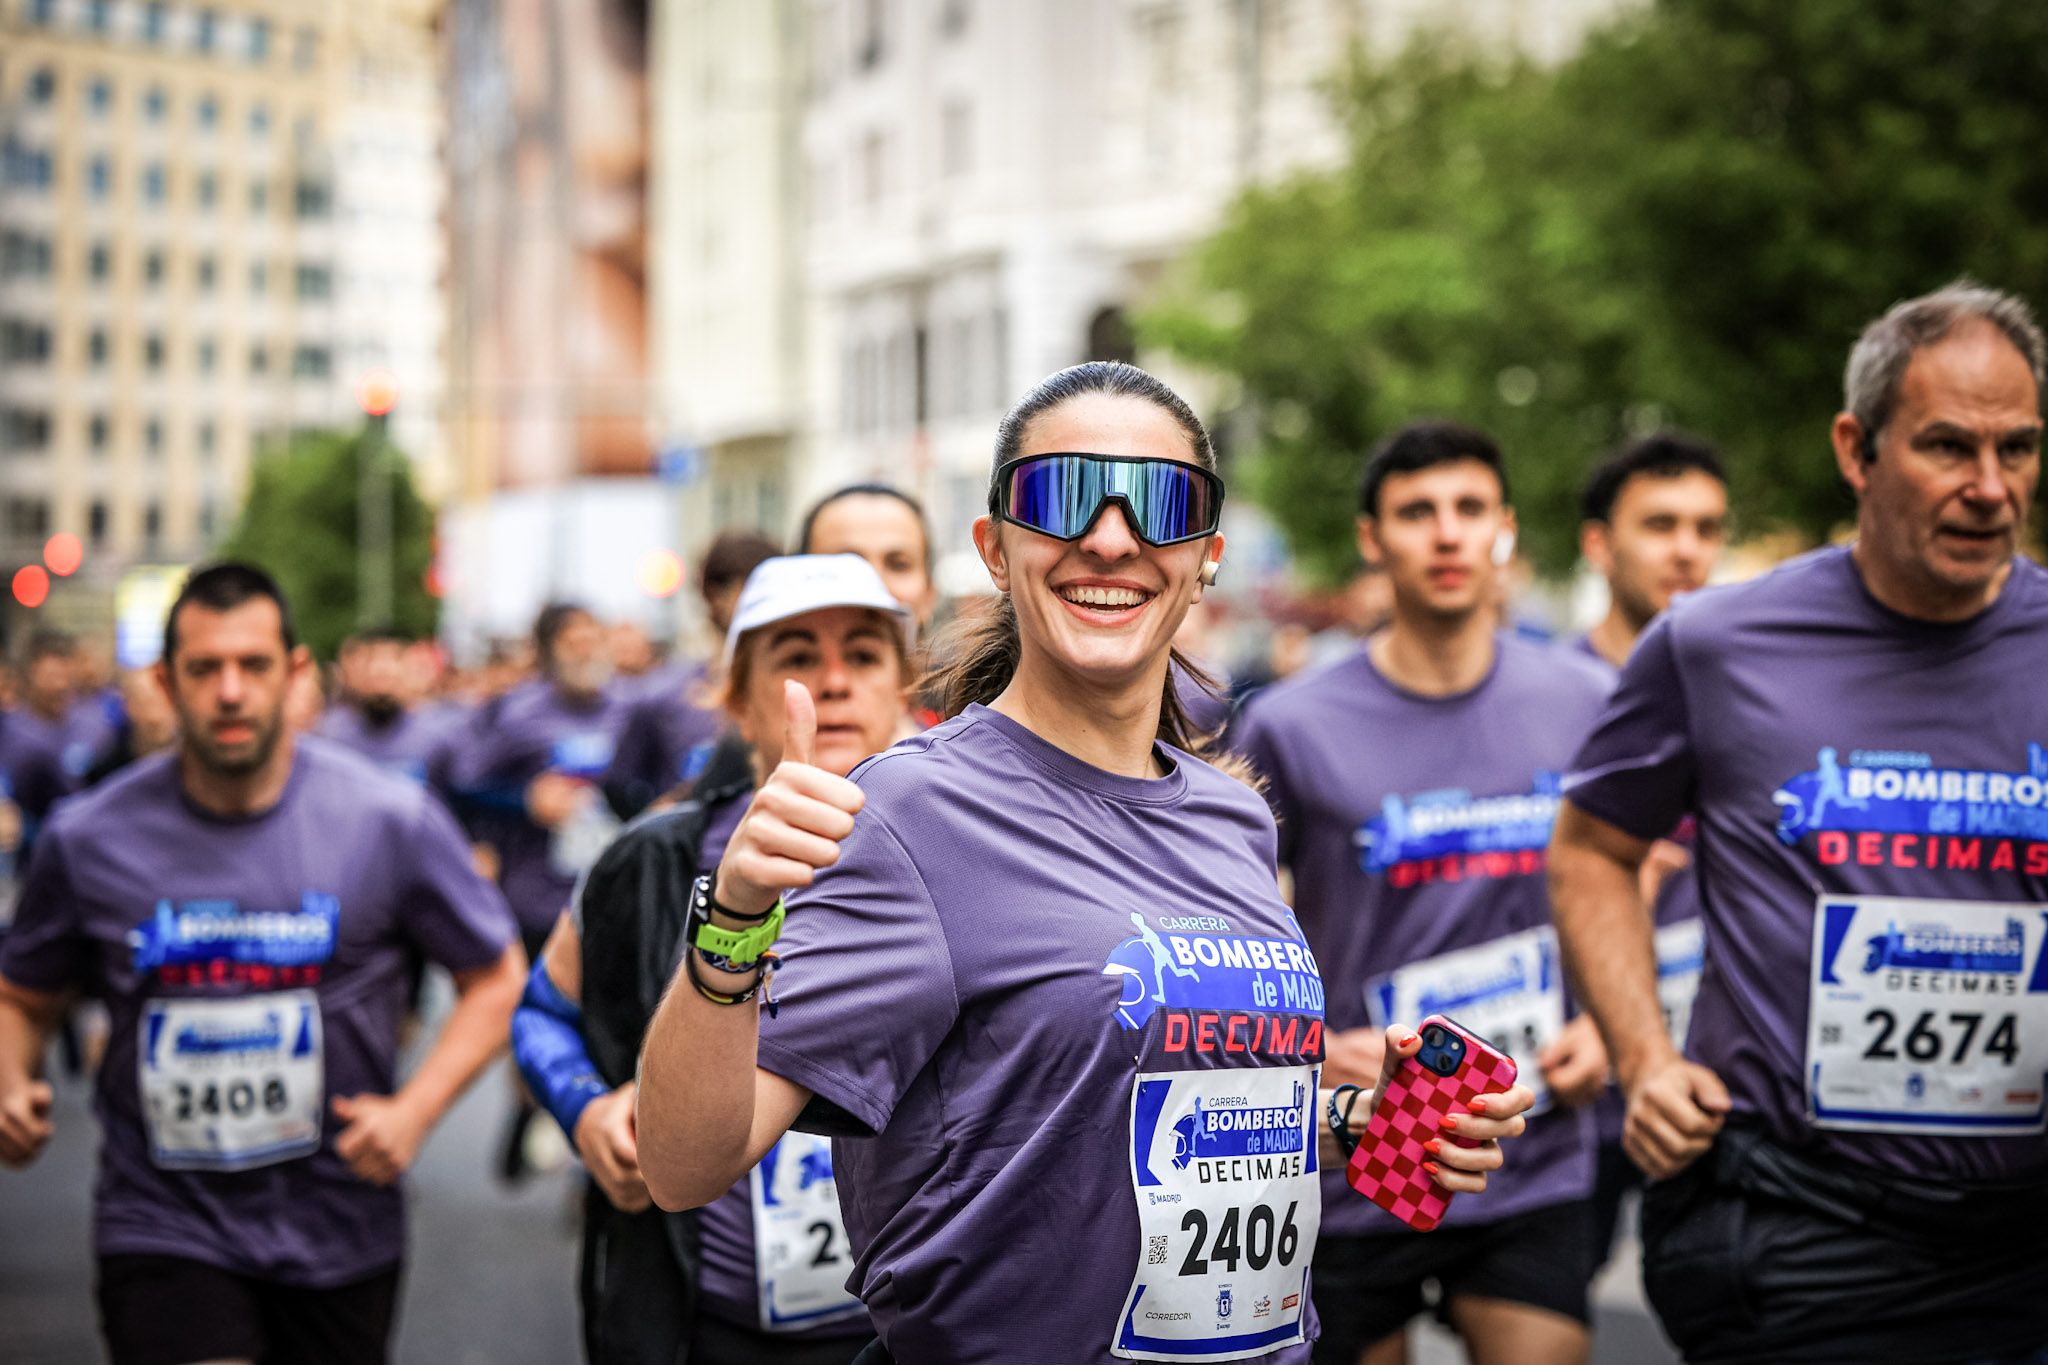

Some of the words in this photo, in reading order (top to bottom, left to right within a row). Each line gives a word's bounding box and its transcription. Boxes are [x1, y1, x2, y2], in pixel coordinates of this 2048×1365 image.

[1849, 768, 2048, 808] BOMBERO
[1817, 830, 2048, 876] DECIMAS
[1159, 916, 1231, 932] CARRERA
[1252, 972, 1278, 1008] de
[1886, 971, 2018, 996] DECIMAS
[1165, 1014, 1323, 1057] DECIMA
[1862, 1008, 2021, 1067] 2674
[173, 1076, 288, 1122] 2408
[1208, 1096, 1248, 1108] CARRERA
[1247, 1131, 1261, 1153] de
[1197, 1155, 1300, 1184] DECIMAS
[1156, 1193, 1182, 1204] MADRID
[1178, 1200, 1299, 1277] 2406
